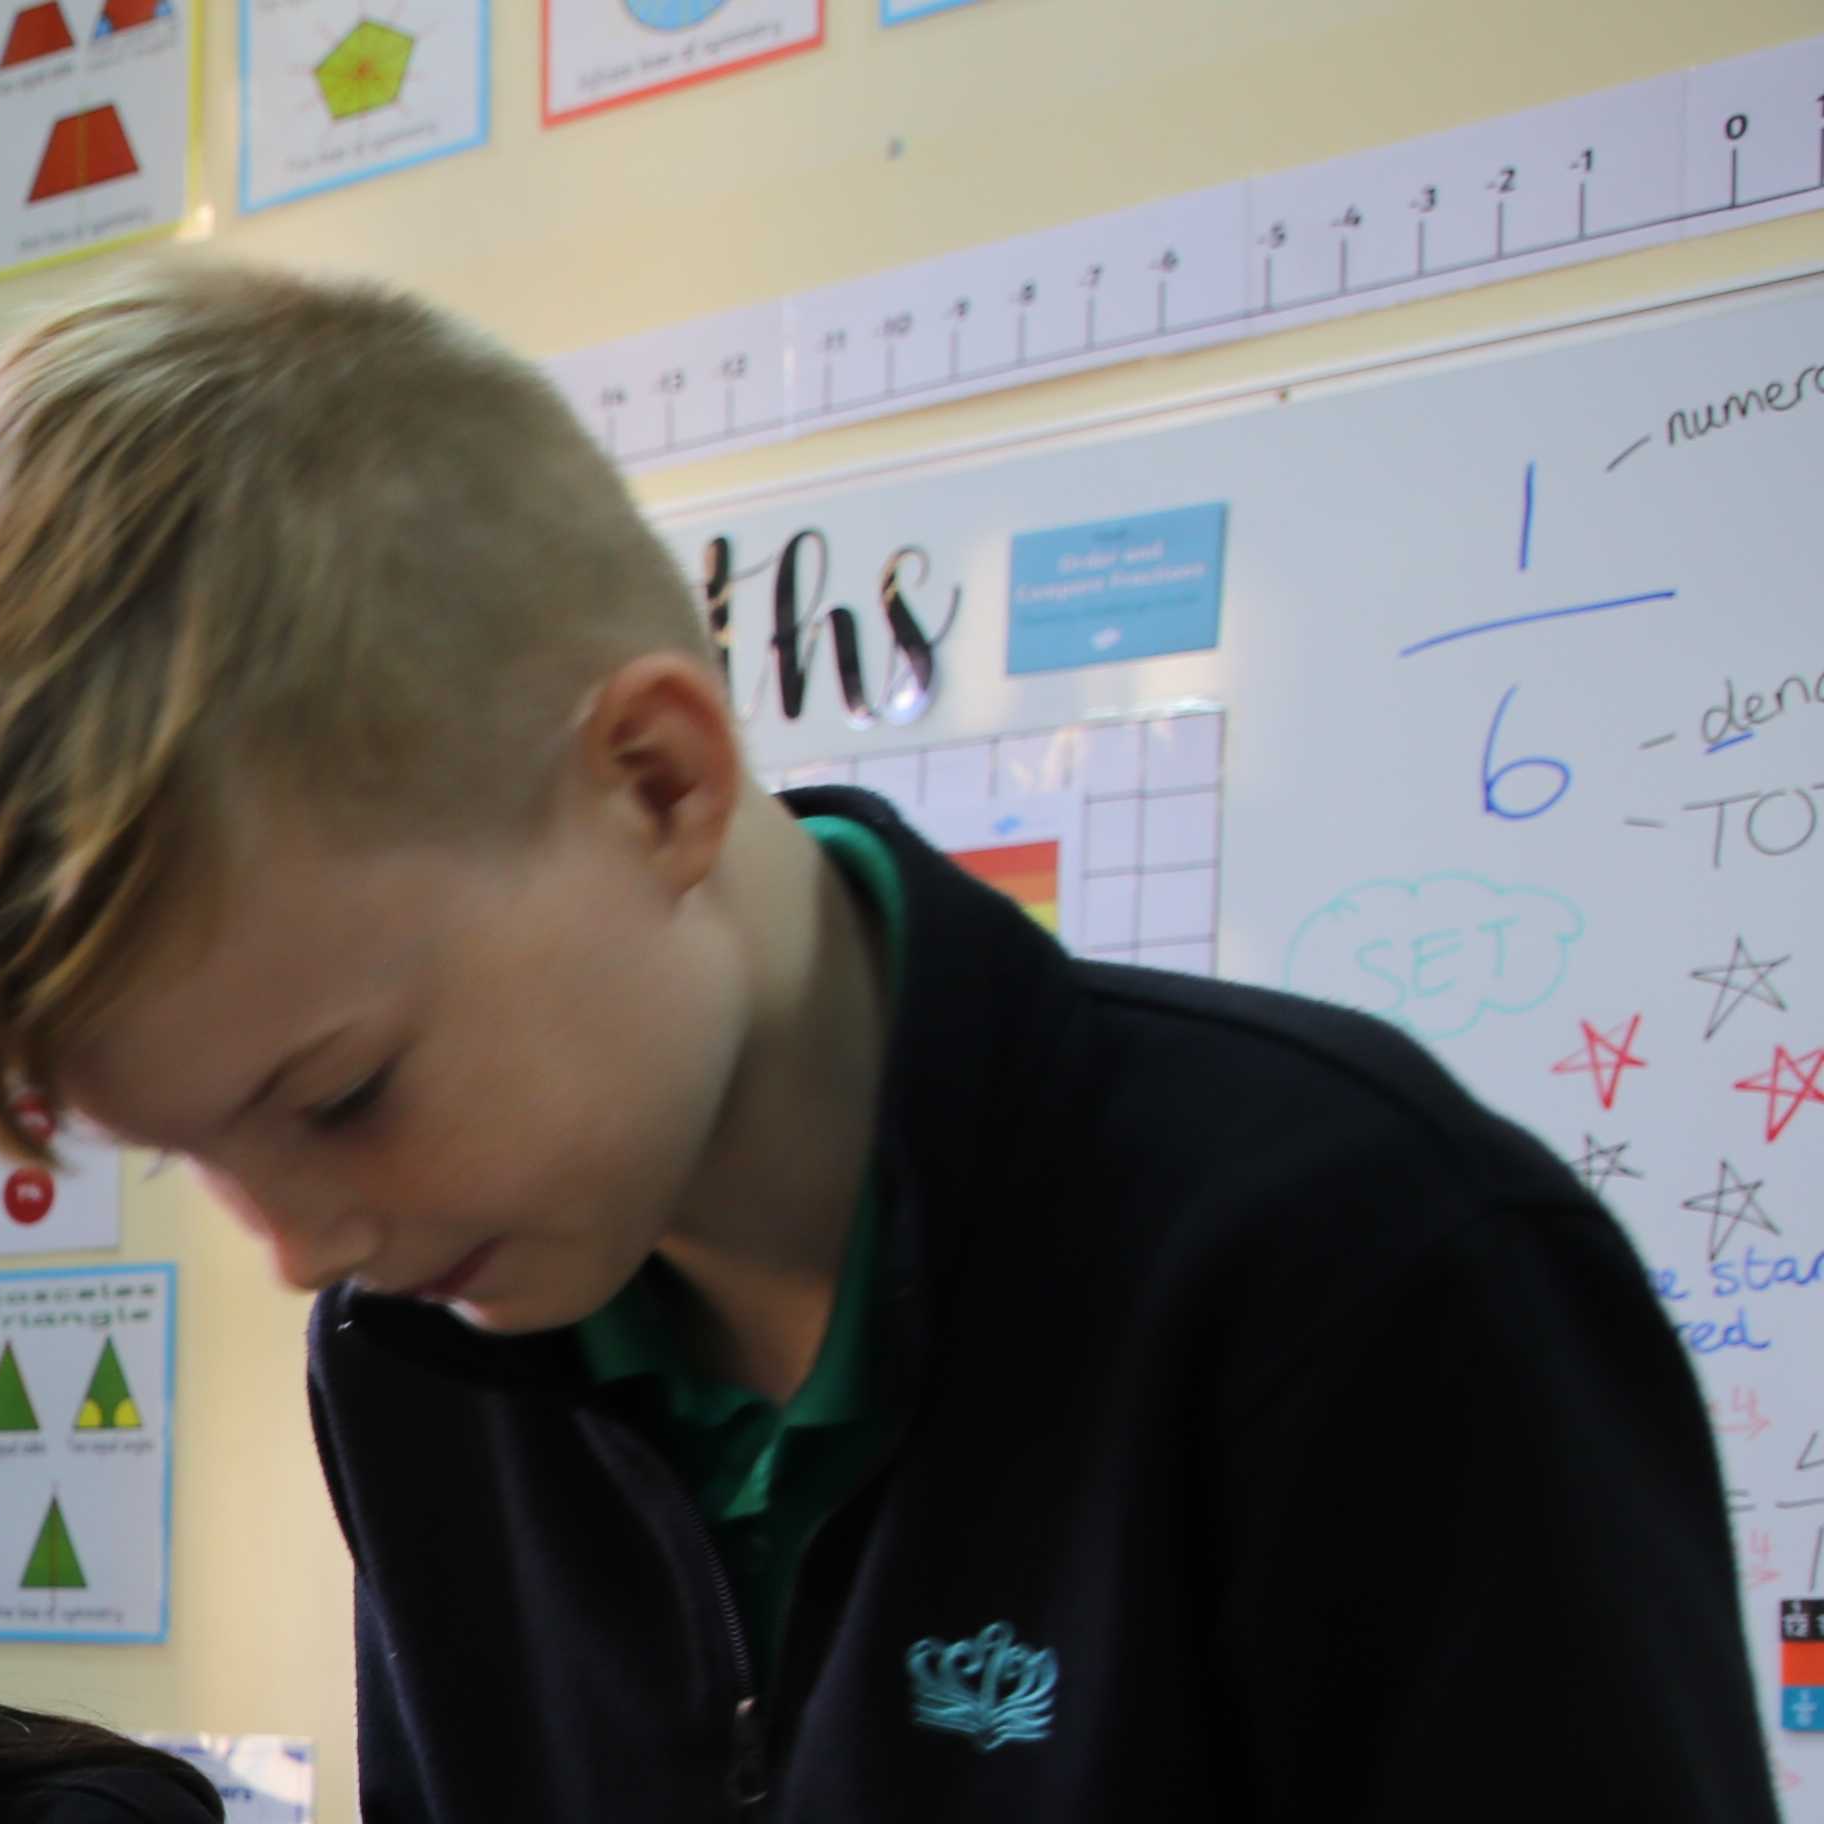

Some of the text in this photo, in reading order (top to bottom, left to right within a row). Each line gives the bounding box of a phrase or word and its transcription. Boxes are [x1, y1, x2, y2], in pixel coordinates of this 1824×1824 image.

[1257, 221, 1288, 249] -5
[1330, 204, 1363, 230] -4
[1409, 186, 1439, 213] -3
[1484, 166, 1519, 194] -2
[1569, 147, 1596, 173] -1
[1724, 113, 1749, 141] 0
[1518, 460, 1534, 571] 1
[1482, 683, 1573, 821] 6
[1681, 785, 1824, 868] TO
[1355, 914, 1520, 1012] SET
